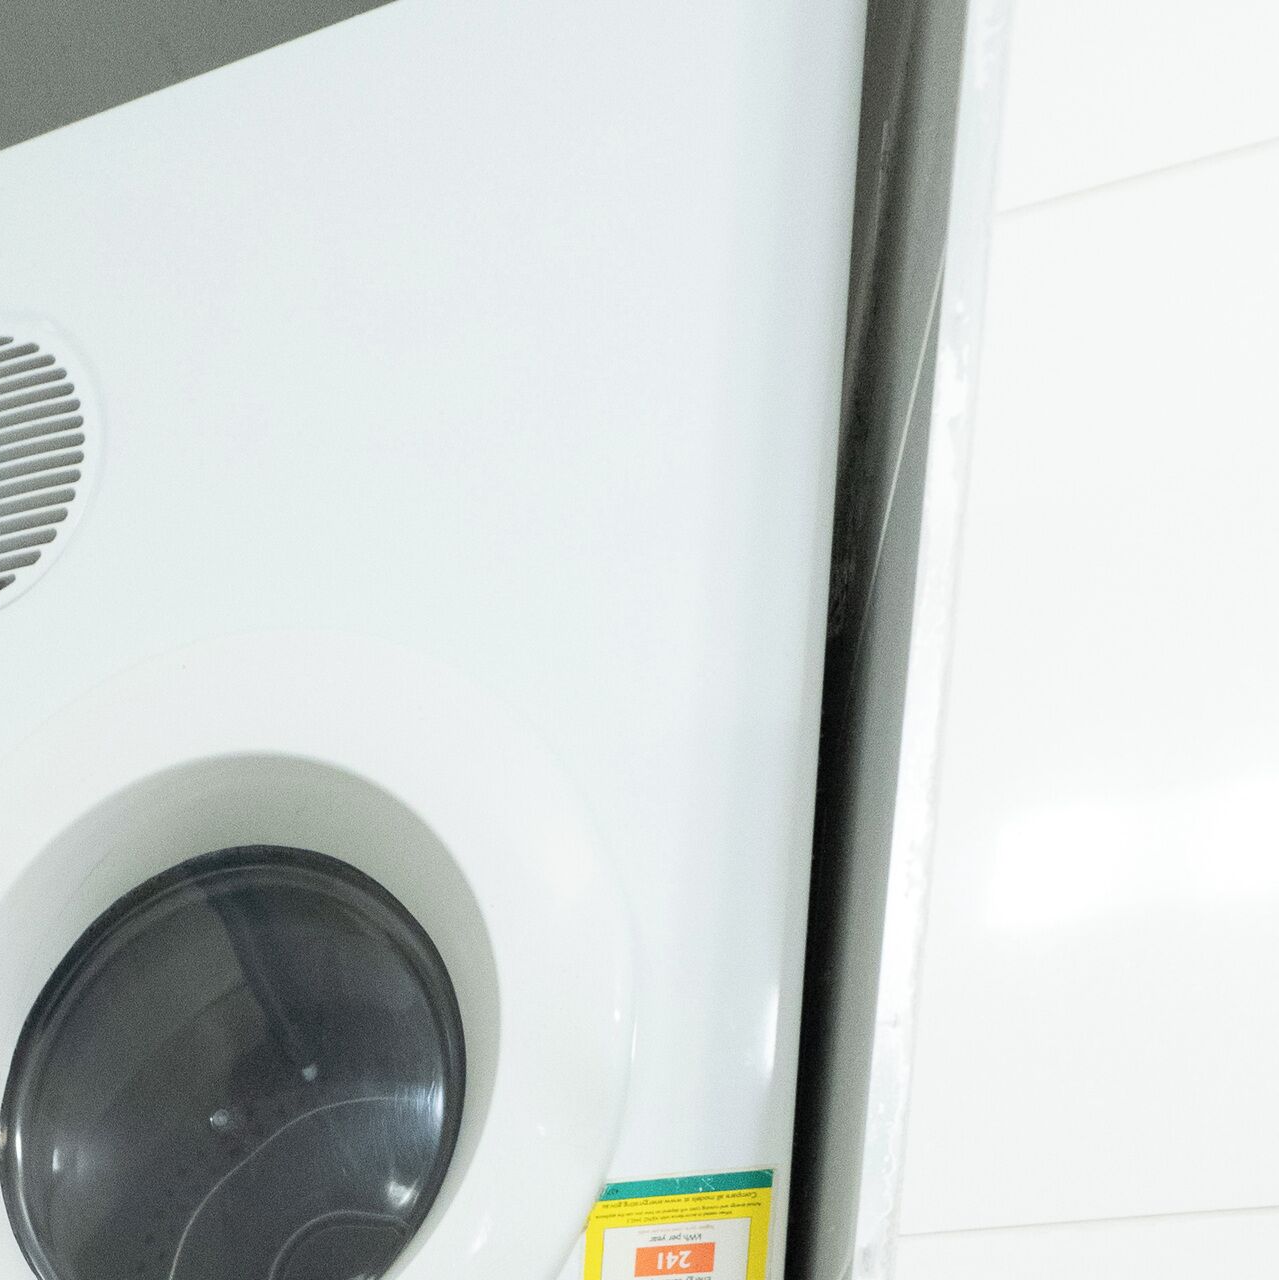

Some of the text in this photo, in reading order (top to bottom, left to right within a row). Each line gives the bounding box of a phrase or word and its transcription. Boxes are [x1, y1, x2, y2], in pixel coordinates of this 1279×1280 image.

[649, 1234, 666, 1242] year
[683, 1233, 702, 1242] kWh
[657, 1250, 692, 1270] 241
